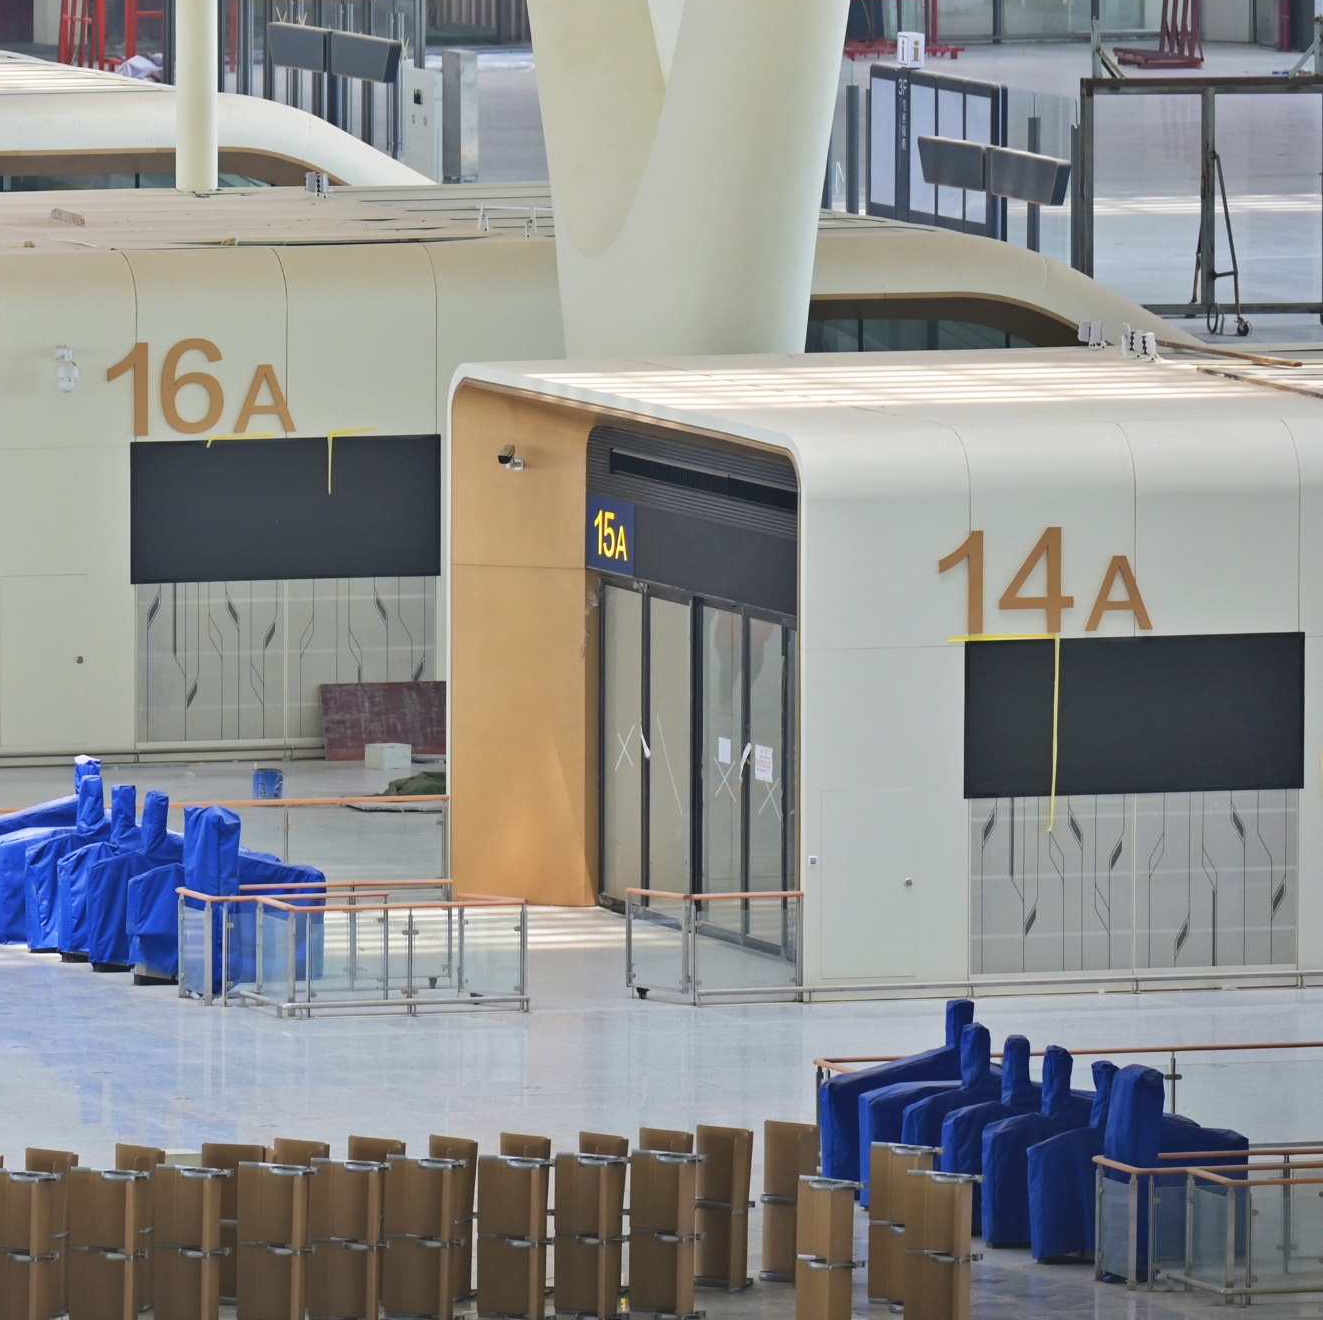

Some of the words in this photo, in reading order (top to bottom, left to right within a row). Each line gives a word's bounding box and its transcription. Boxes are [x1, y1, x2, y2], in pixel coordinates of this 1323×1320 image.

[107, 337, 297, 437] 16A
[593, 508, 629, 562] 15A
[938, 526, 1153, 635] 14A
